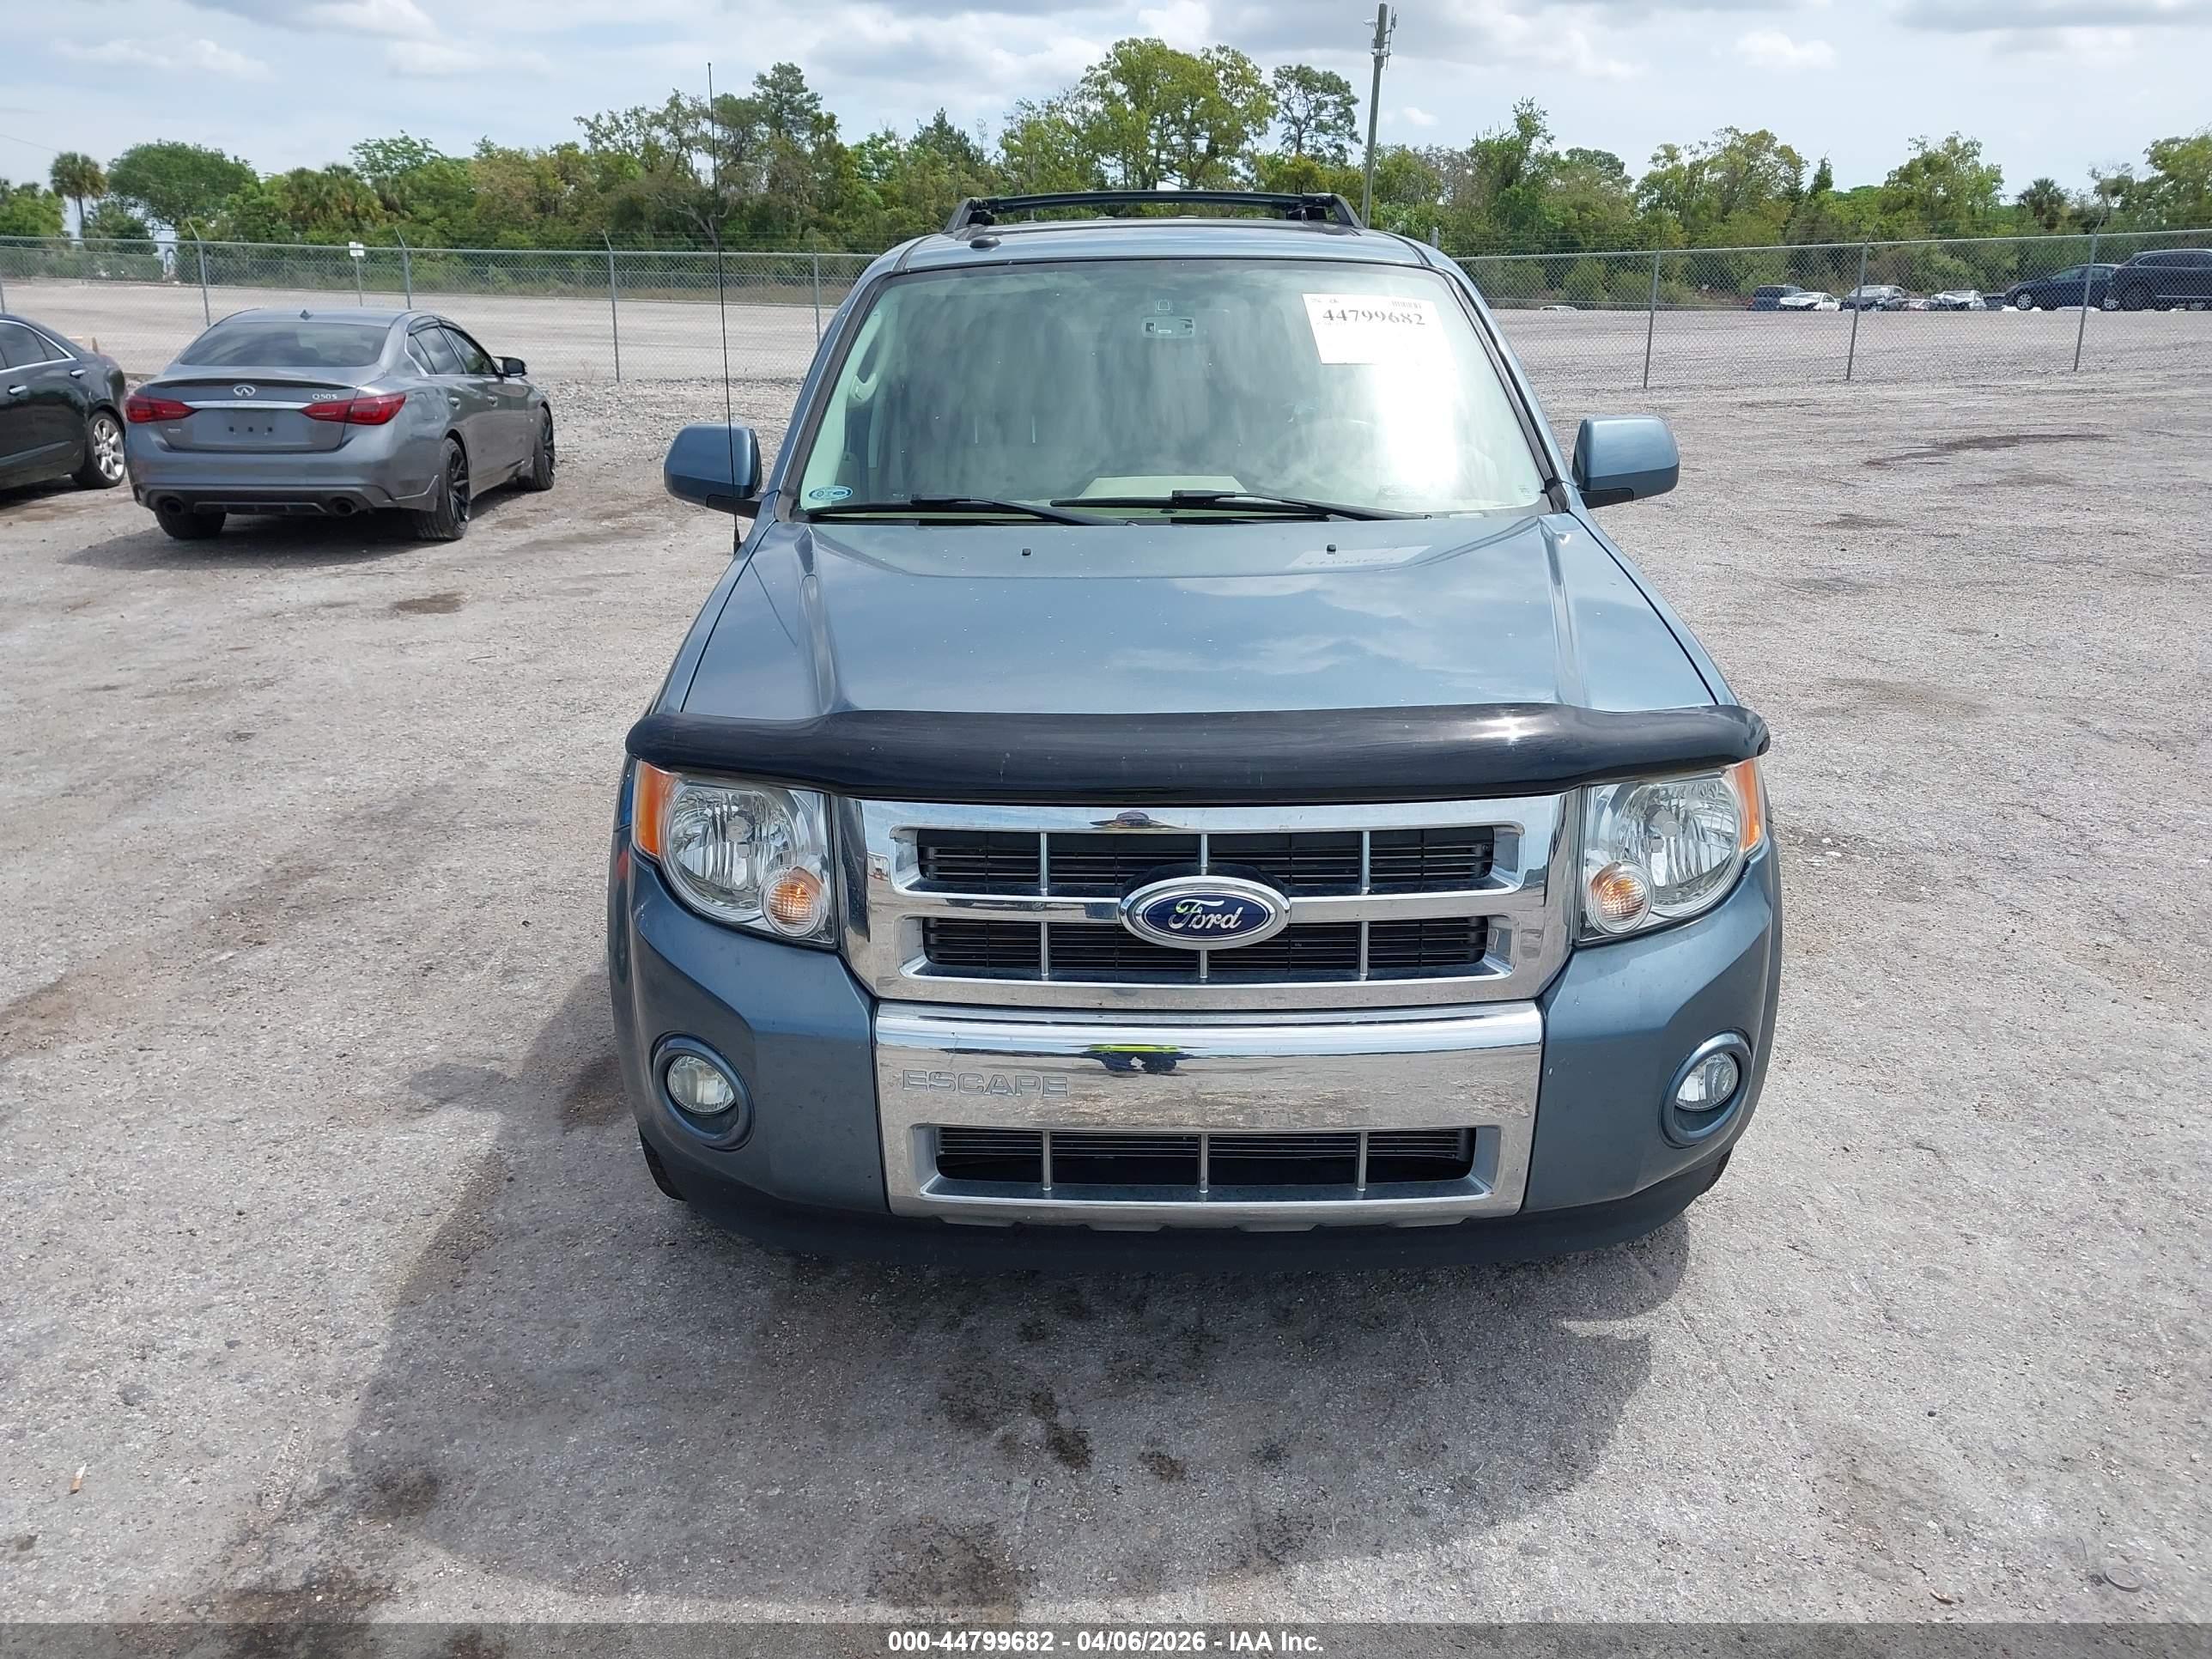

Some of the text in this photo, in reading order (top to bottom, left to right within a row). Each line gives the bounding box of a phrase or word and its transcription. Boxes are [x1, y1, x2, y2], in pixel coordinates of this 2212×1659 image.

[1322, 308, 1425, 325] 44799682
[1169, 899, 1243, 929] Ford
[902, 1070, 1069, 1097] ESCAPE
